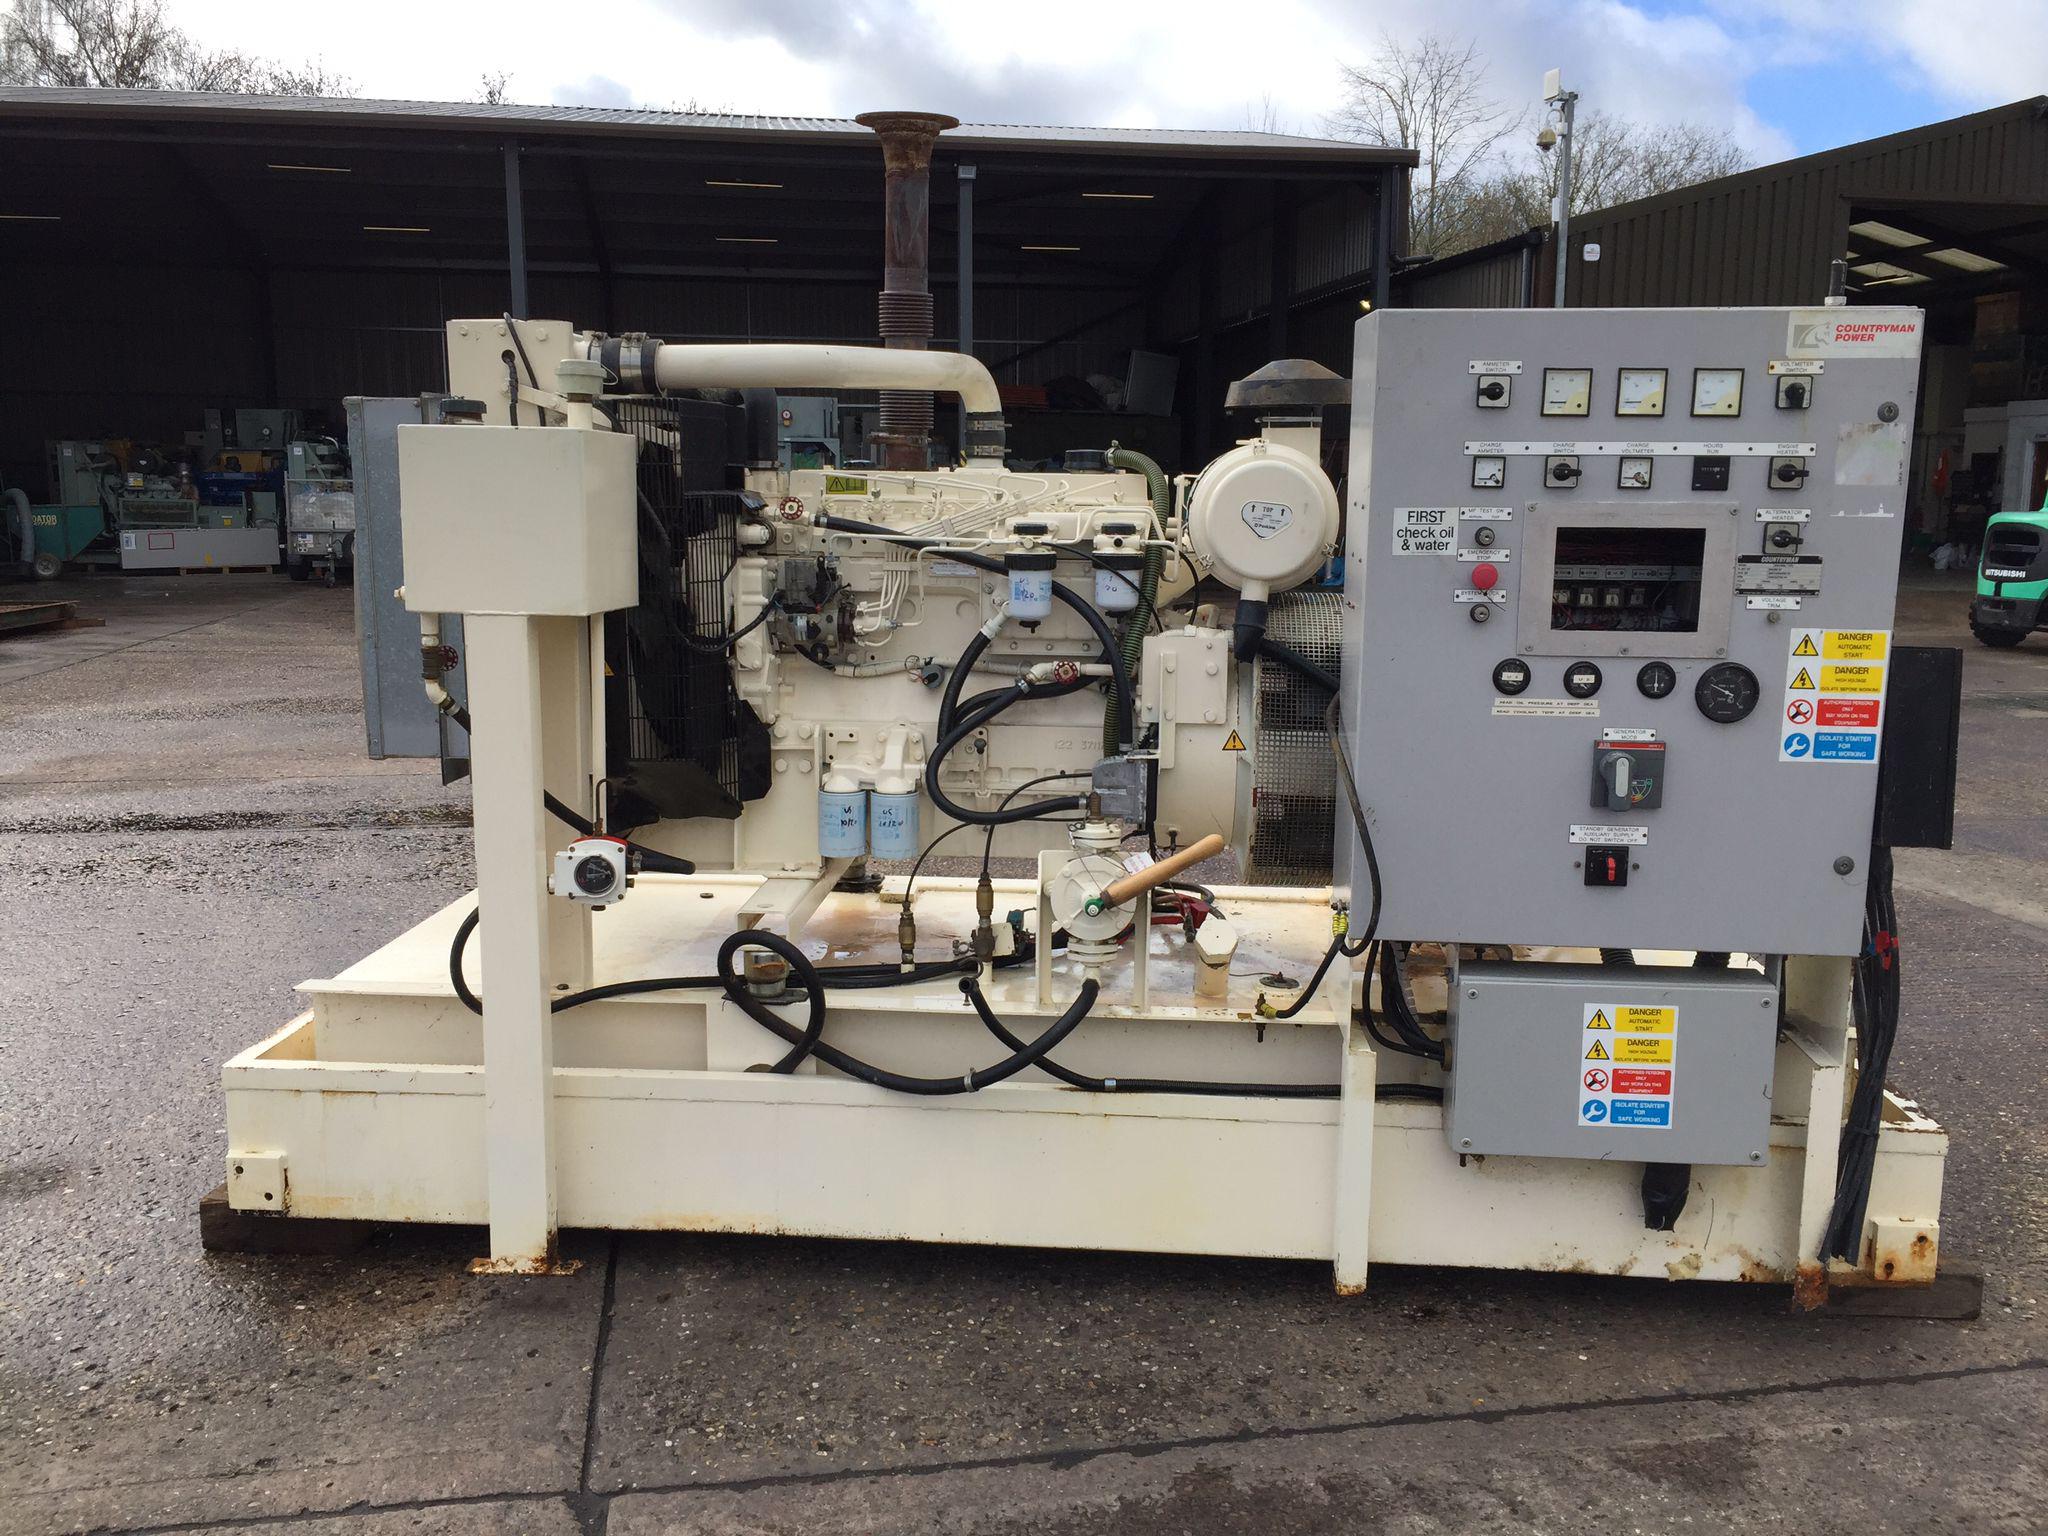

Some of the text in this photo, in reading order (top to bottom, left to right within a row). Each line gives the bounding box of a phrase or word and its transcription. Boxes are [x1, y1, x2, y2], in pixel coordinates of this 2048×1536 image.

[1836, 324, 1916, 333] COUNTRYMAN
[1834, 334, 1875, 342] POWER
[1408, 510, 1446, 522] FIRST
[1396, 526, 1454, 538] check oil
[1401, 539, 1450, 551] & water
[1985, 568, 2026, 578] MITSUBISHI
